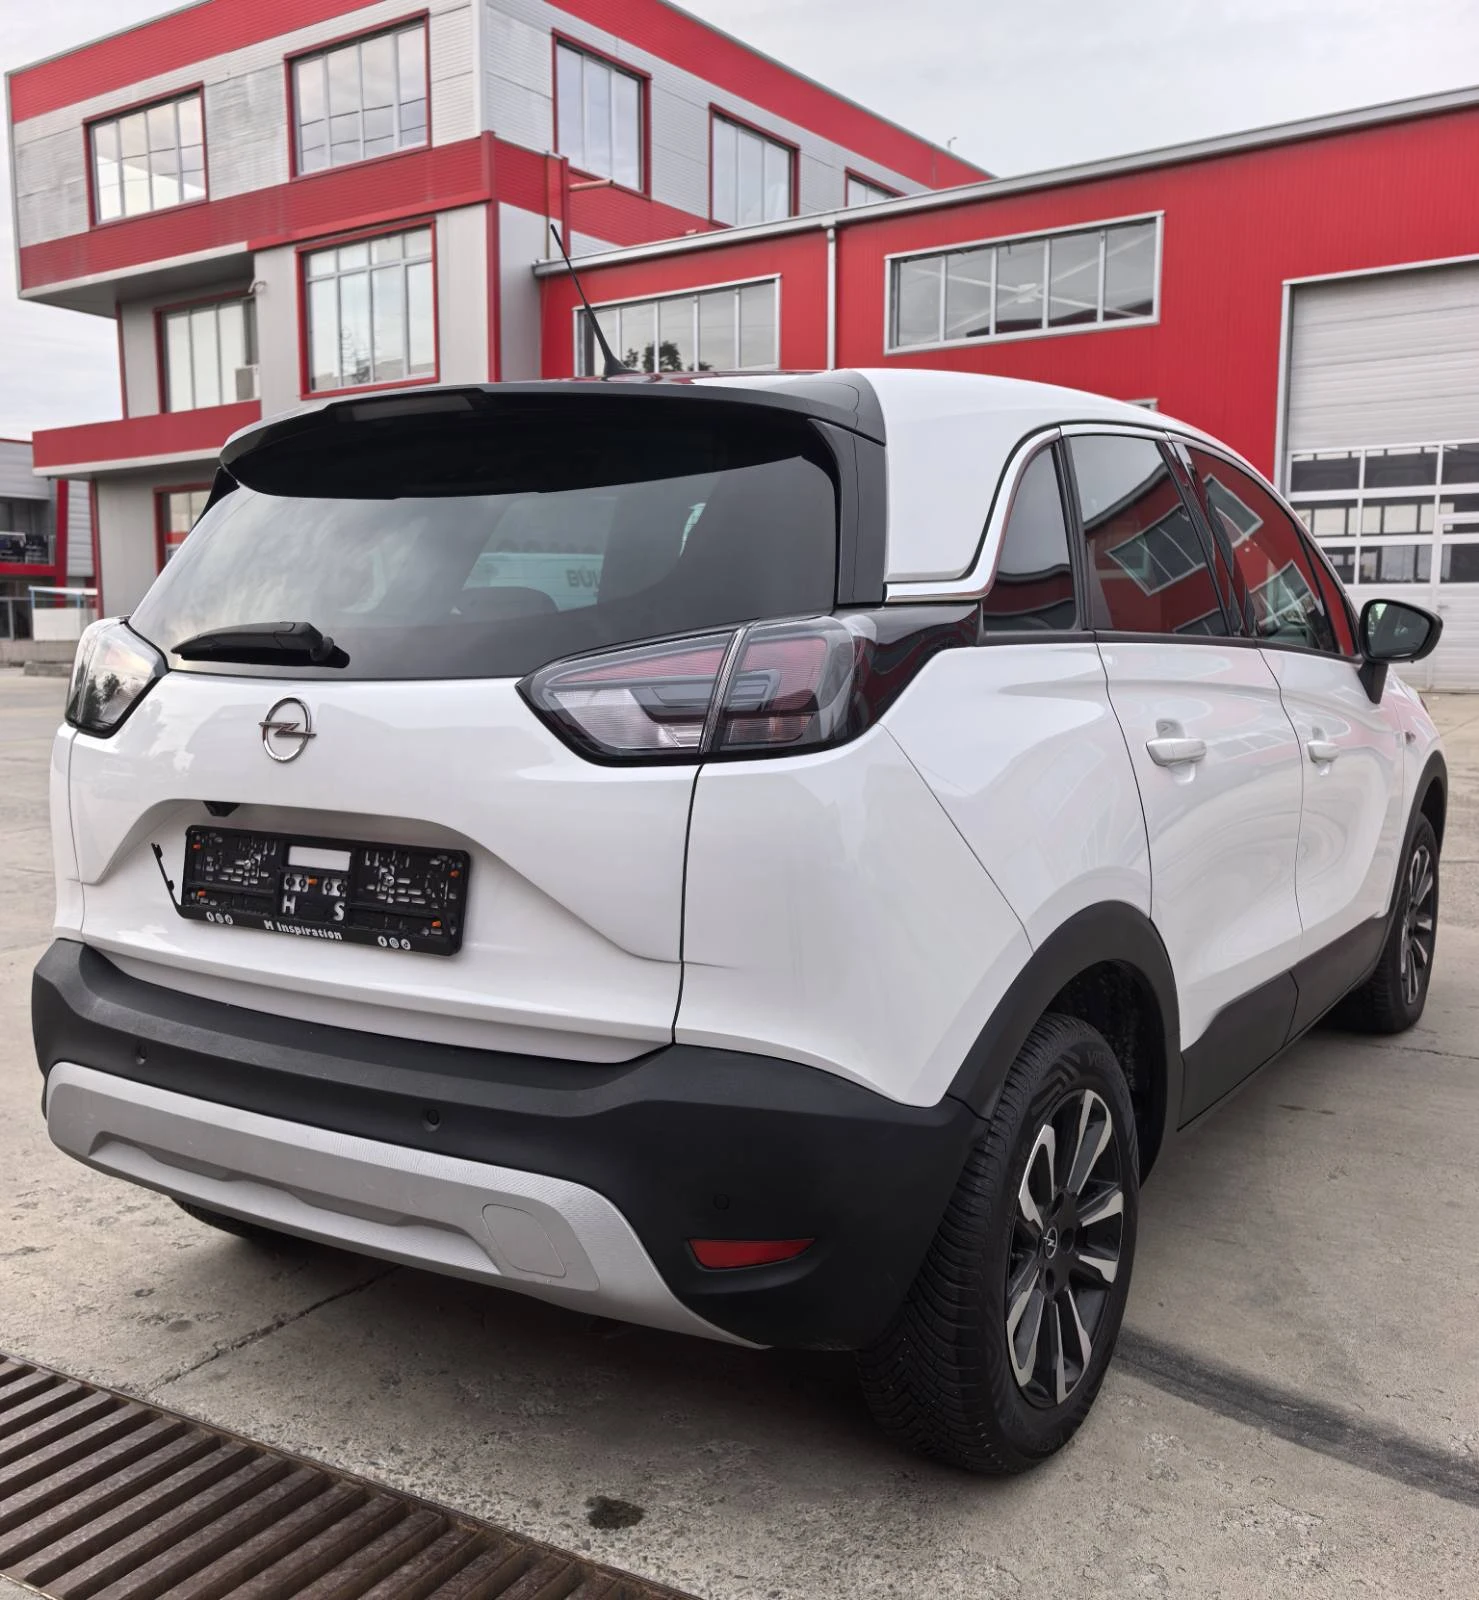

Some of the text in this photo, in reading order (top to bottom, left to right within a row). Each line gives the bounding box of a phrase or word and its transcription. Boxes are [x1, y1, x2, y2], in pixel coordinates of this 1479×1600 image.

[282, 895, 345, 921] H S
[276, 922, 343, 940] Inspiration
